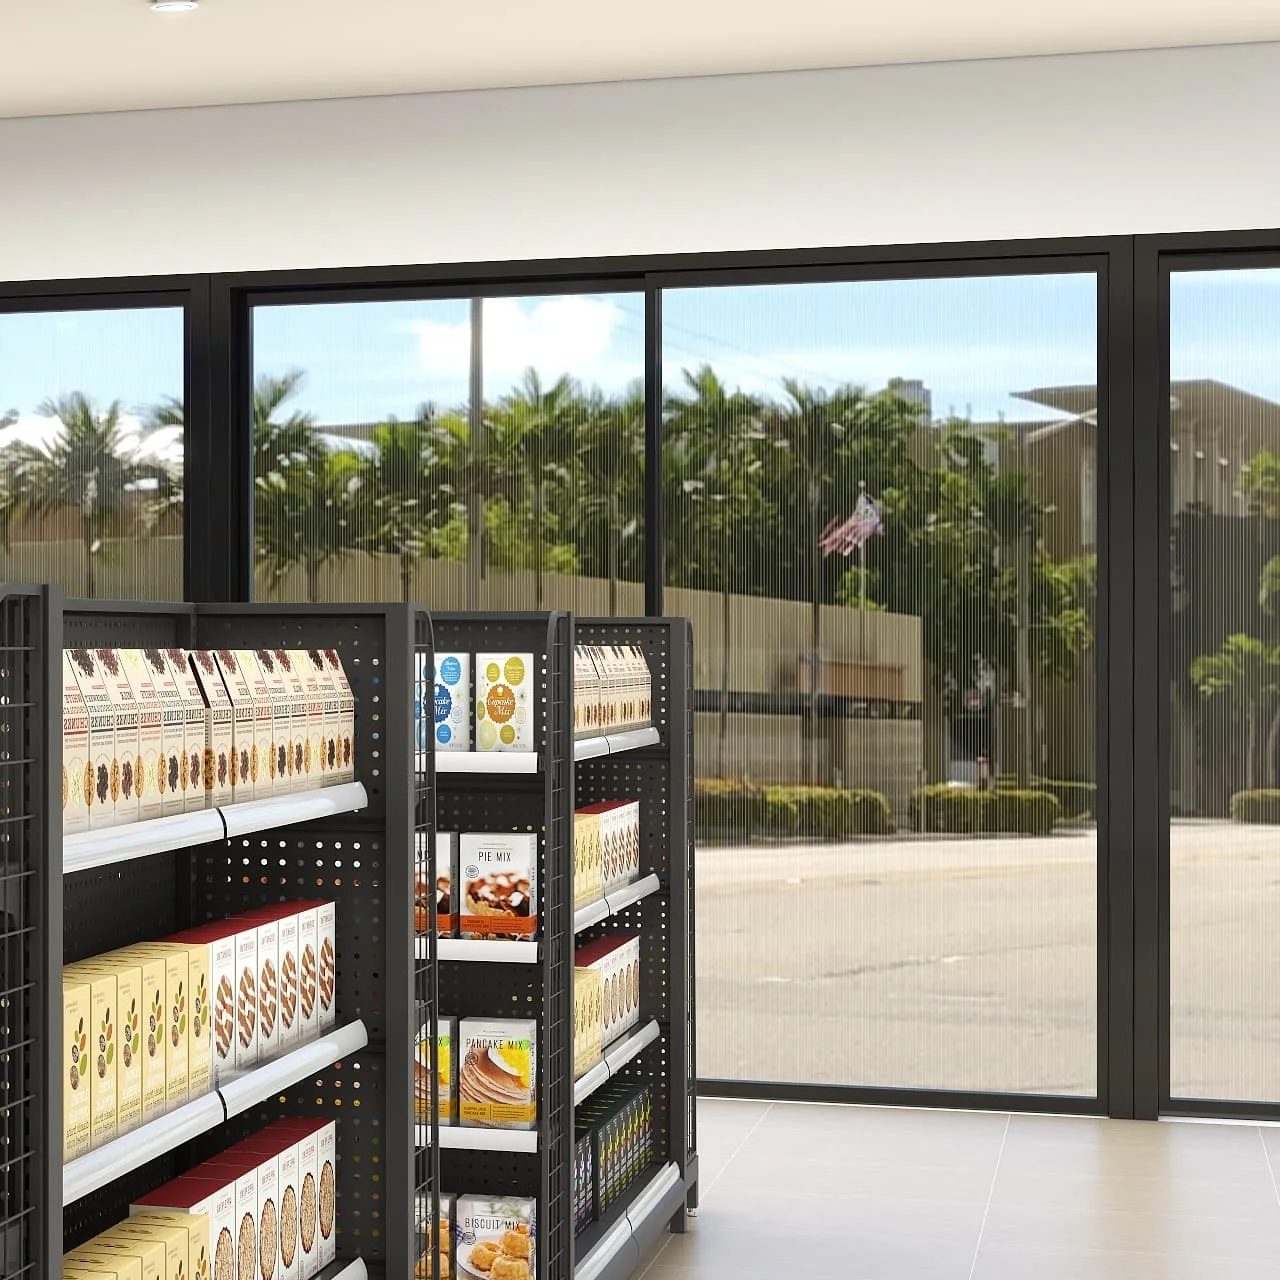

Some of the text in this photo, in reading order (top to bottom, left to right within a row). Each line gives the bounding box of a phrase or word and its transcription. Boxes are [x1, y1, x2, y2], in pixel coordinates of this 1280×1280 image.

[479, 851, 511, 862] PIE MIX
[466, 1038, 523, 1050] PANCAKE MIX
[465, 1218, 520, 1231] BISCUIT MIX
